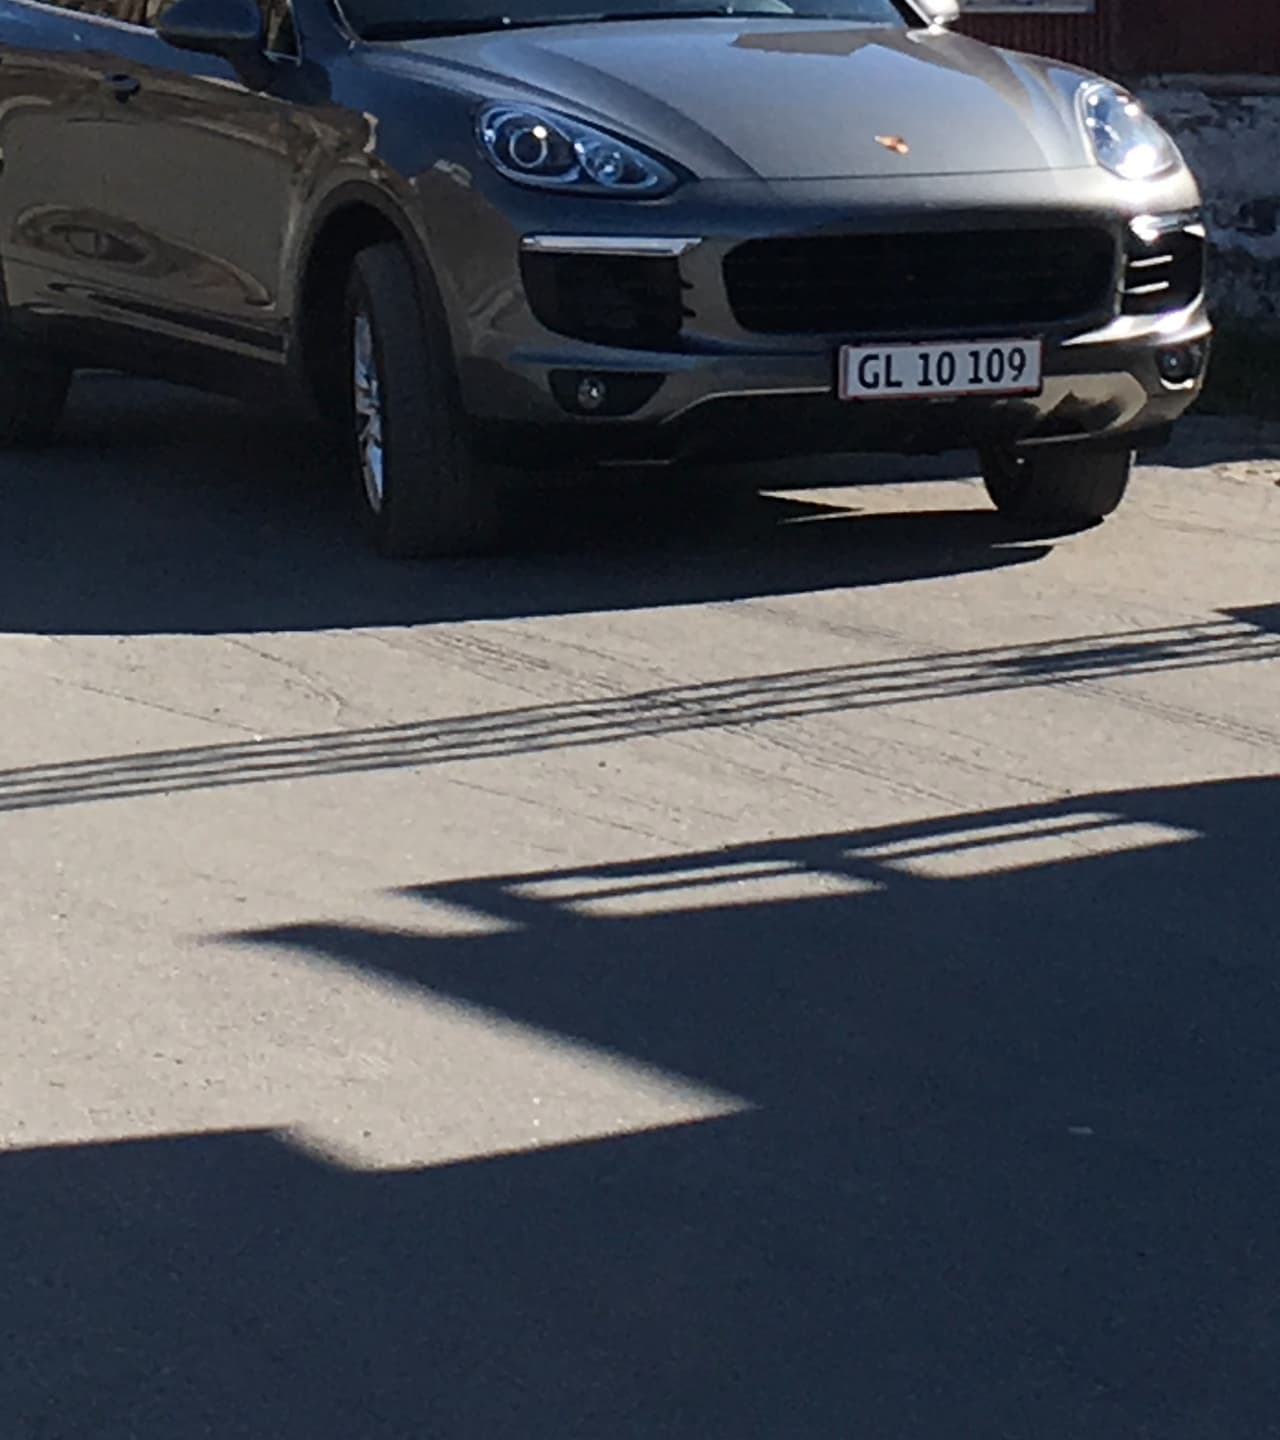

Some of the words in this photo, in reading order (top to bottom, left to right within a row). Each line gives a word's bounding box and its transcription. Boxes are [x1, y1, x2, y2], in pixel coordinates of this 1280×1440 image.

[858, 354, 903, 389] GL
[917, 351, 956, 386] 10
[968, 347, 1027, 384] 109
